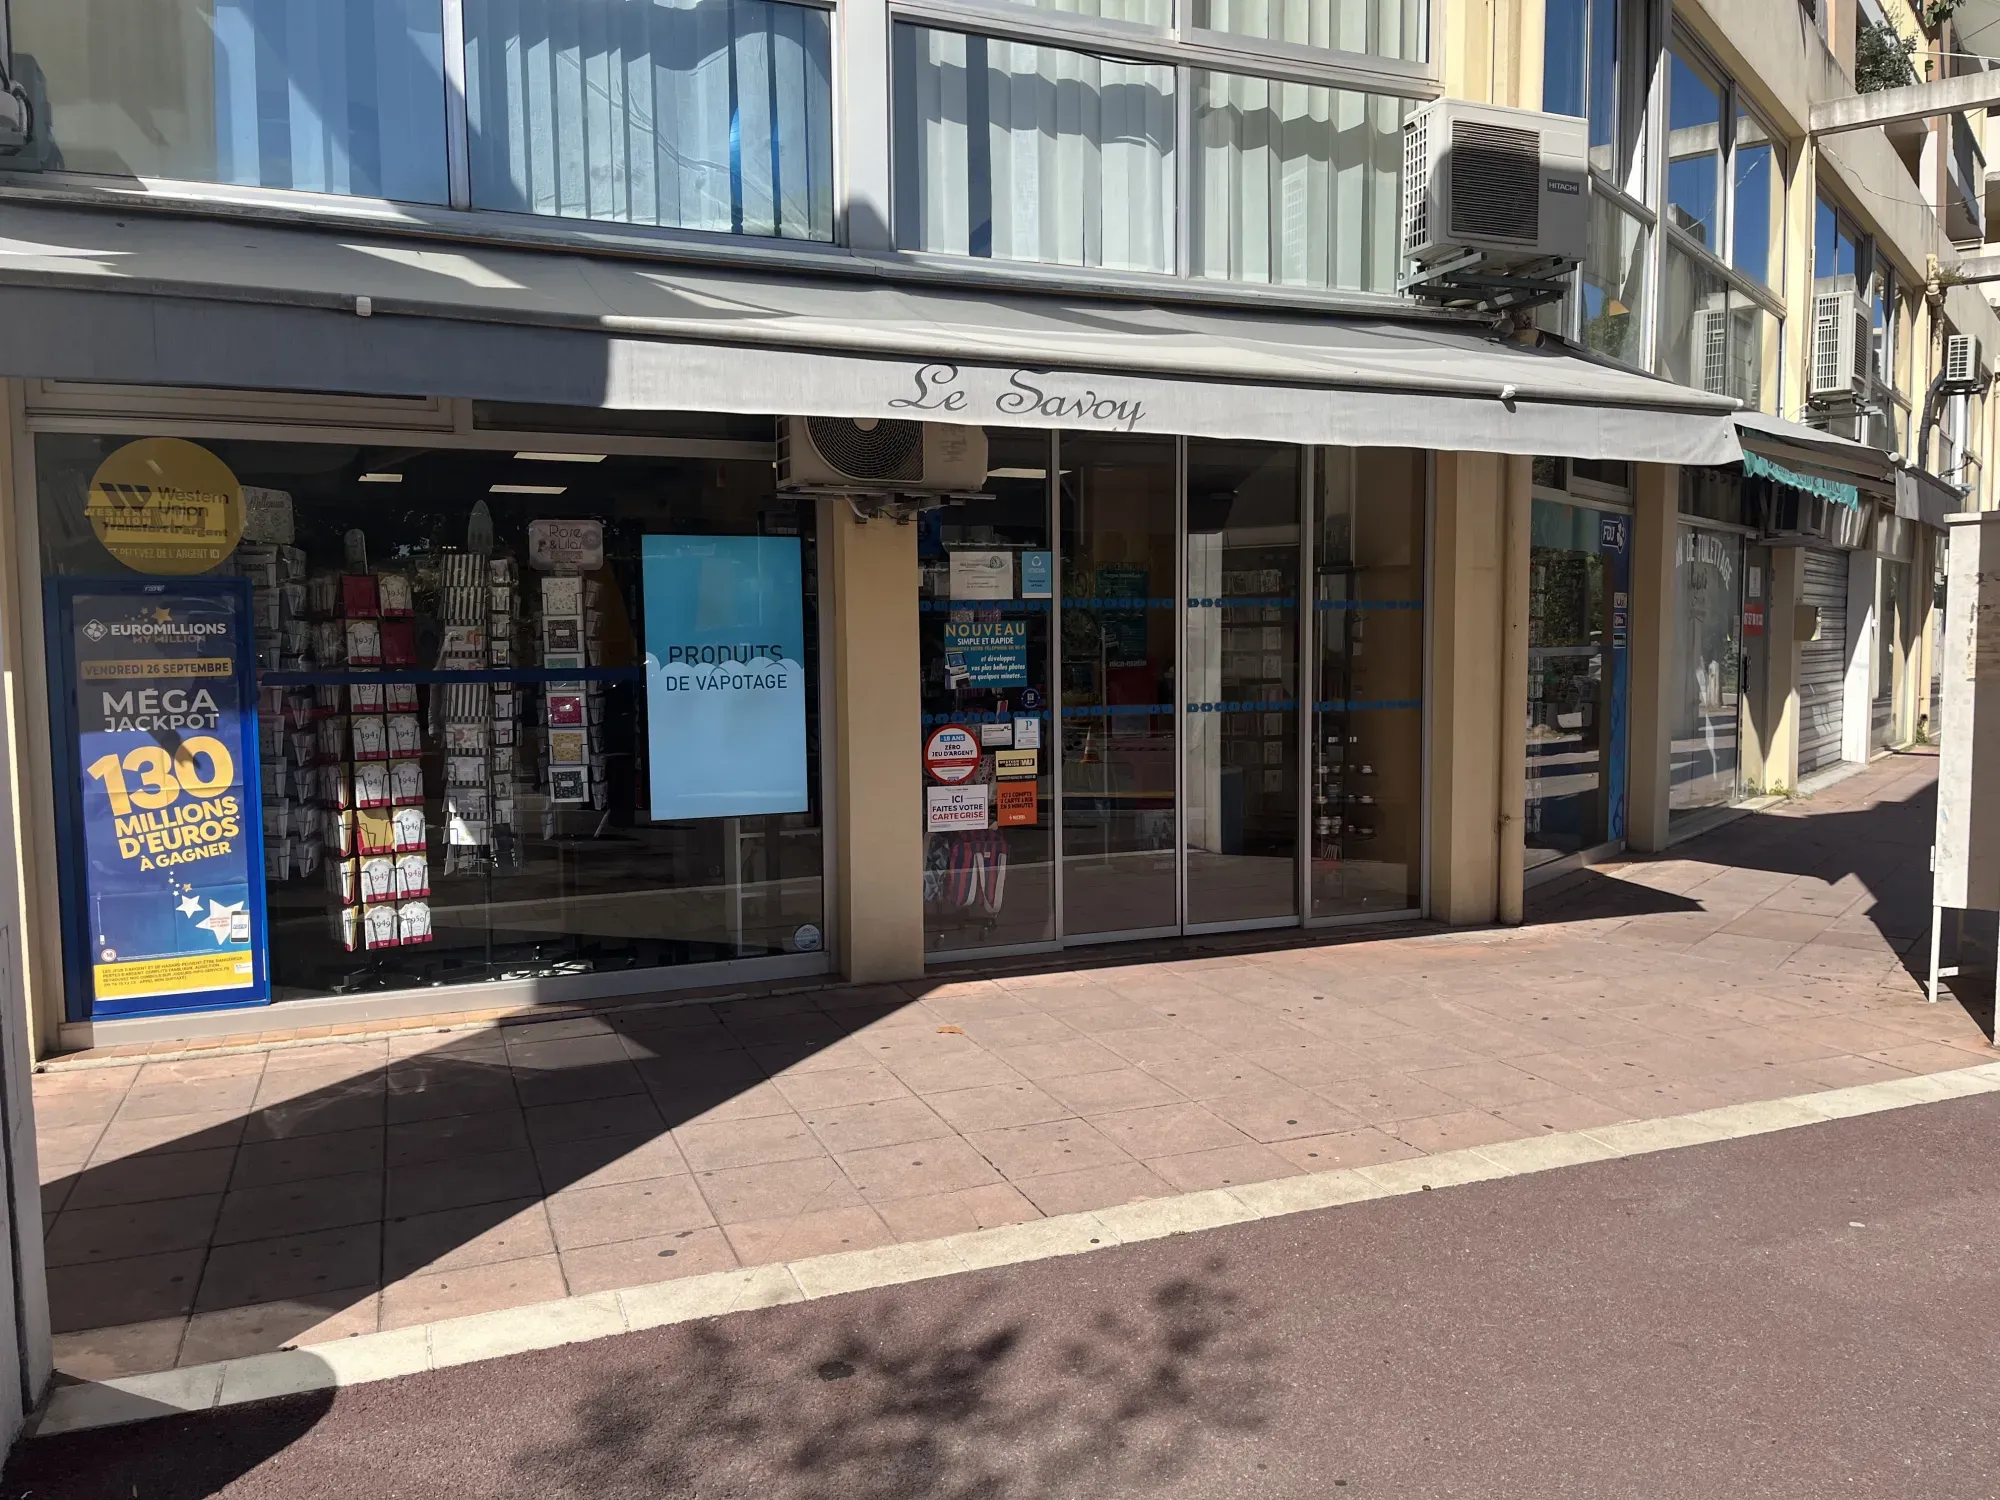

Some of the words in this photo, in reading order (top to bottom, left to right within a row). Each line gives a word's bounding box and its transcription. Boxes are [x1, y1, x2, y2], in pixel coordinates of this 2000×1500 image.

[1548, 182, 1578, 191] HITACHI
[888, 363, 967, 410] Le
[996, 368, 1146, 432] Savoy
[157, 486, 229, 504] Western
[158, 501, 208, 517] Union
[549, 524, 582, 538] Rose
[1603, 525, 1616, 541] FDJ
[157, 548, 167, 559] DE
[168, 548, 208, 559] L'ARGENT
[210, 549, 220, 559] ICI
[1686, 533, 1695, 562] DE
[111, 623, 227, 636] EUROMILLIONS
[945, 622, 1025, 637] NOUVEAU
[133, 635, 152, 644] MY
[154, 634, 206, 643] MILLION
[355, 636, 373, 644] 1937
[669, 645, 783, 665] PRODUITS
[85, 664, 144, 676] VENDREDI
[147, 664, 160, 673] 26
[163, 662, 229, 673] SEPTEMBRE
[981, 664, 992, 672] plus
[1008, 663, 1026, 672] photos
[1109, 659, 1147, 667] nice-matin
[666, 676, 690, 692] DE
[696, 674, 788, 691] VAPOTAGE
[102, 688, 219, 715] MÉGA
[104, 713, 219, 733] JACKPOT
[361, 731, 379, 740] 1941
[396, 729, 414, 738] 1942
[87, 735, 234, 817] 130
[951, 795, 963, 803] ICI
[959, 803, 984, 811] VOTRE
[114, 796, 238, 838] MILLIONS
[140, 854, 154, 872] À
[155, 841, 232, 868] GAGNER
[371, 873, 388, 882] 1947
